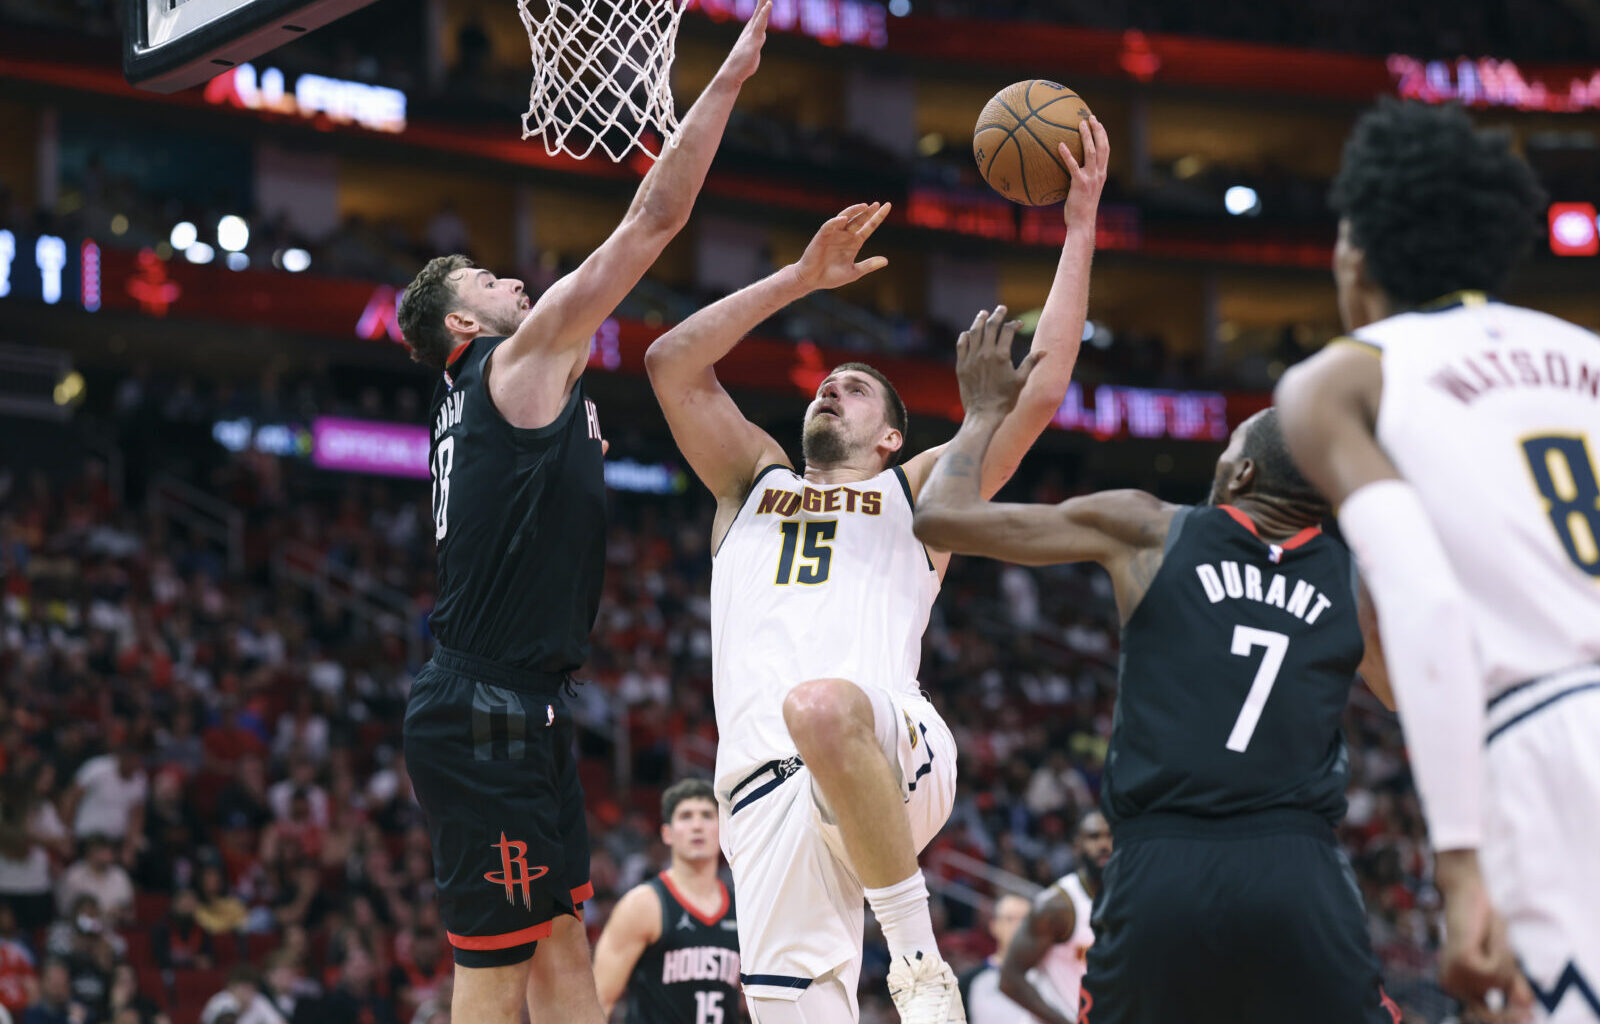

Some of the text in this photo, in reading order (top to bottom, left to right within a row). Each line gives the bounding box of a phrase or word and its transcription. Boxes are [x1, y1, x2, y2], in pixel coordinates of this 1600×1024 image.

[1517, 430, 1600, 580] 8
[774, 520, 838, 586] 15
[1196, 561, 1332, 625] DURANT
[1225, 624, 1290, 753] 7
[694, 990, 724, 1024] 15
